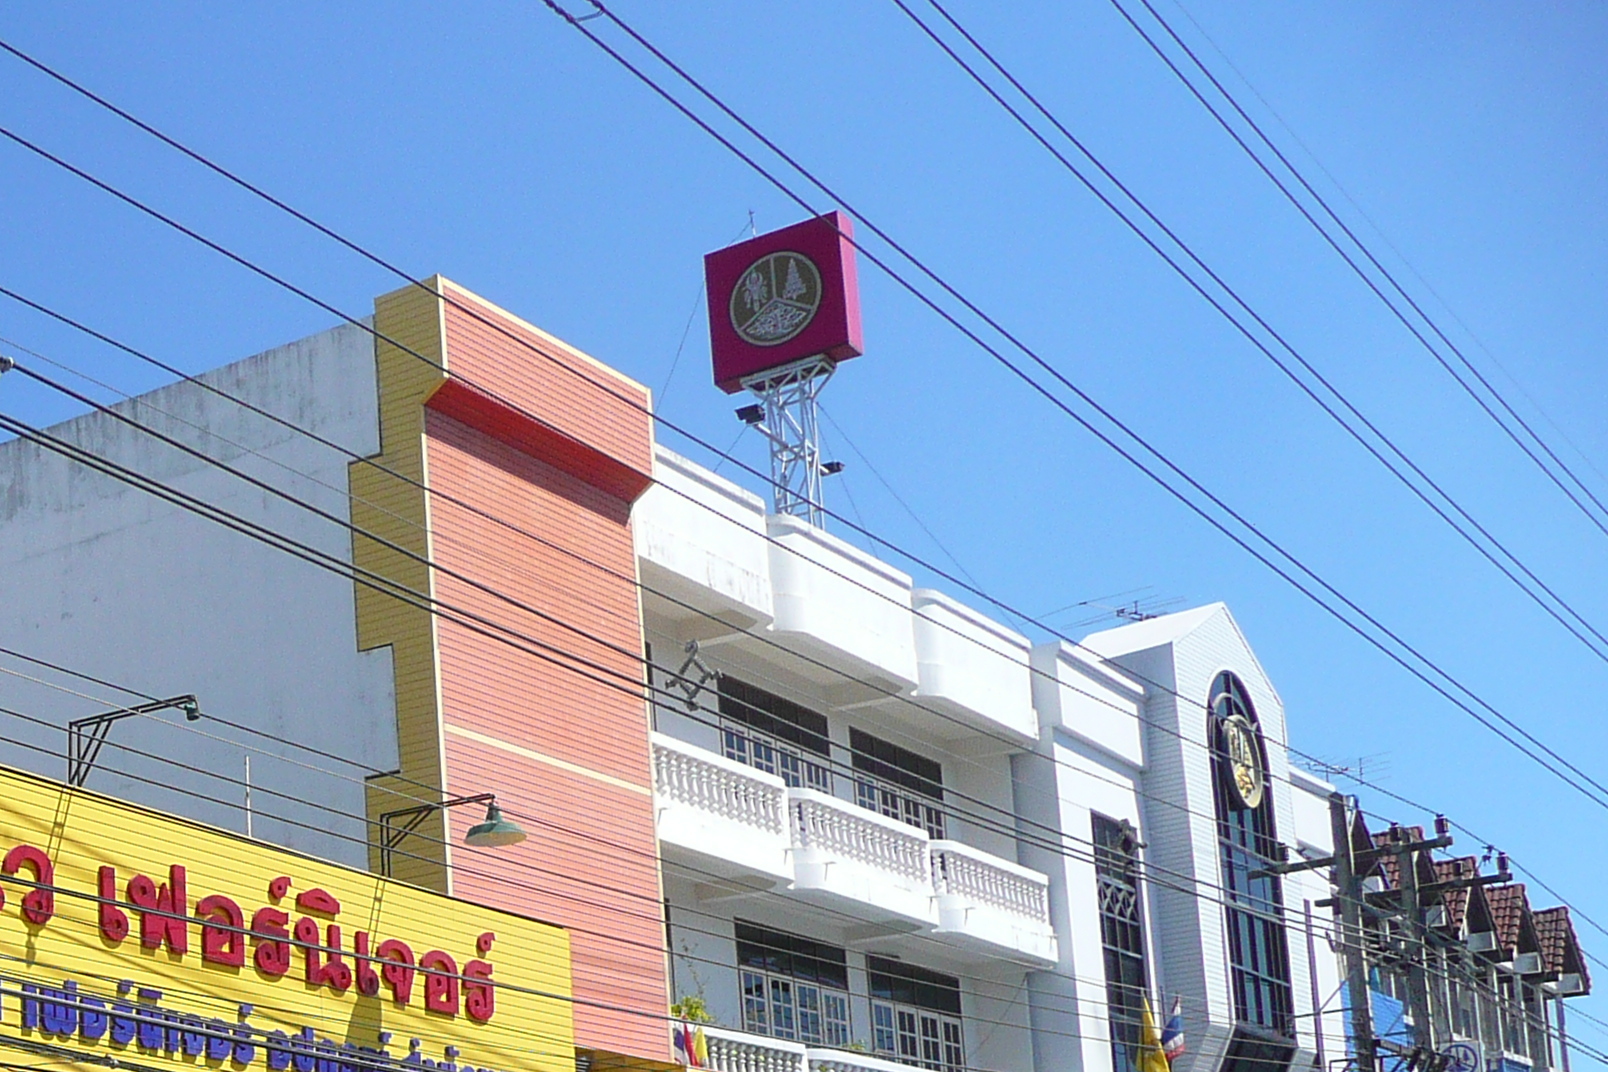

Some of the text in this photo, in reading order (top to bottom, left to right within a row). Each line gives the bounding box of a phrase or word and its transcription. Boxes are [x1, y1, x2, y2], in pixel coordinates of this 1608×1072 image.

[98, 864, 496, 1020] เฟอร์นิเจอร์
